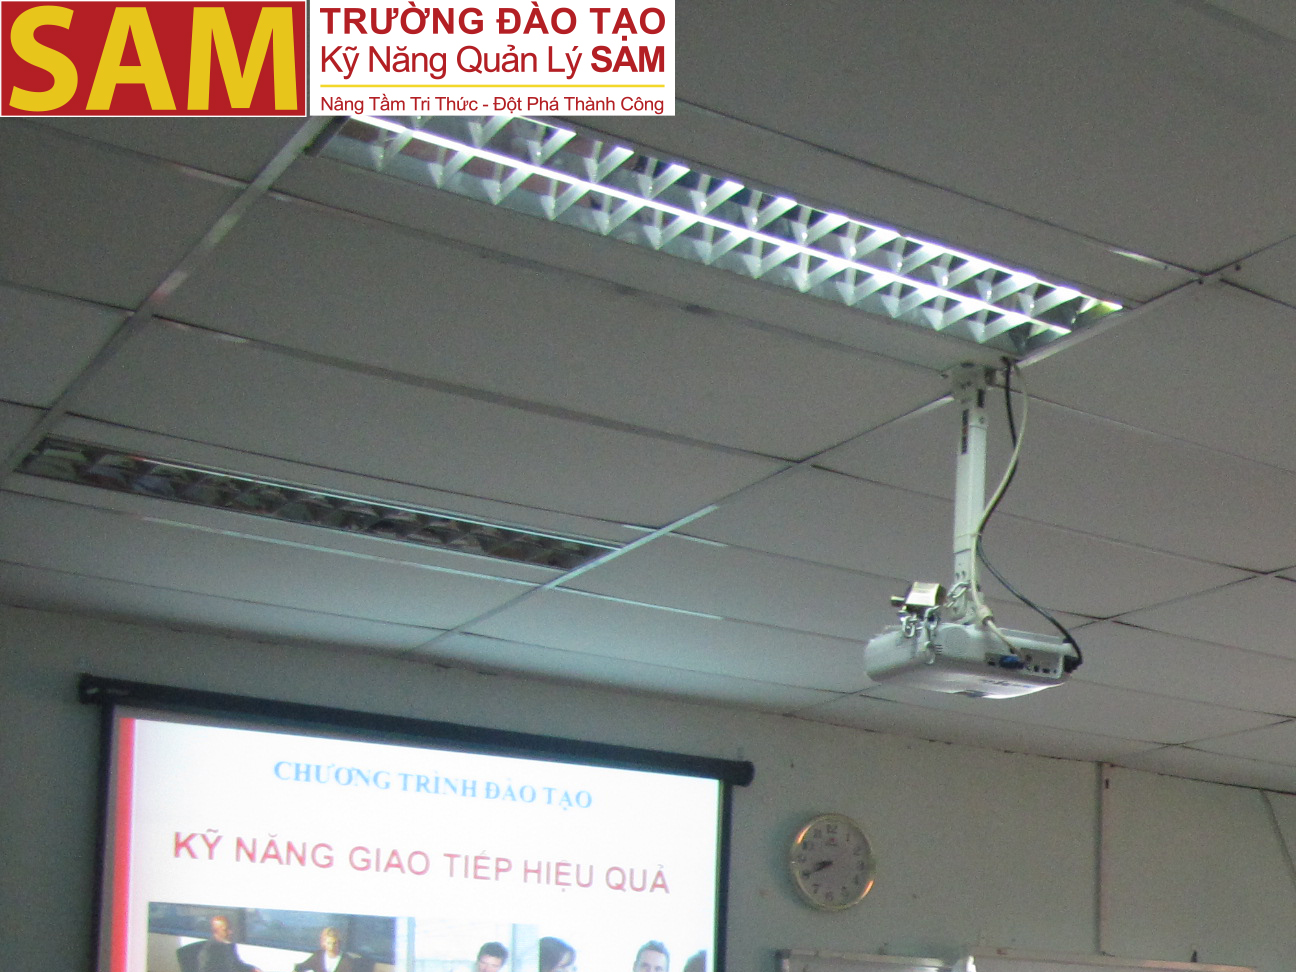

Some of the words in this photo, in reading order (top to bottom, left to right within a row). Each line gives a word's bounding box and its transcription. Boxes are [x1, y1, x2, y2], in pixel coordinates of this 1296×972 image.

[273, 760, 392, 791] CHƯƠNG
[398, 770, 478, 799] TRÌNH
[542, 786, 593, 811] TẠO
[173, 828, 224, 860] KỸ
[235, 832, 335, 869] NĂNG
[348, 845, 431, 876] GIAO
[443, 849, 513, 881] TIẾP
[523, 858, 594, 893] HIỆU
[605, 863, 670, 895] QUẢ
